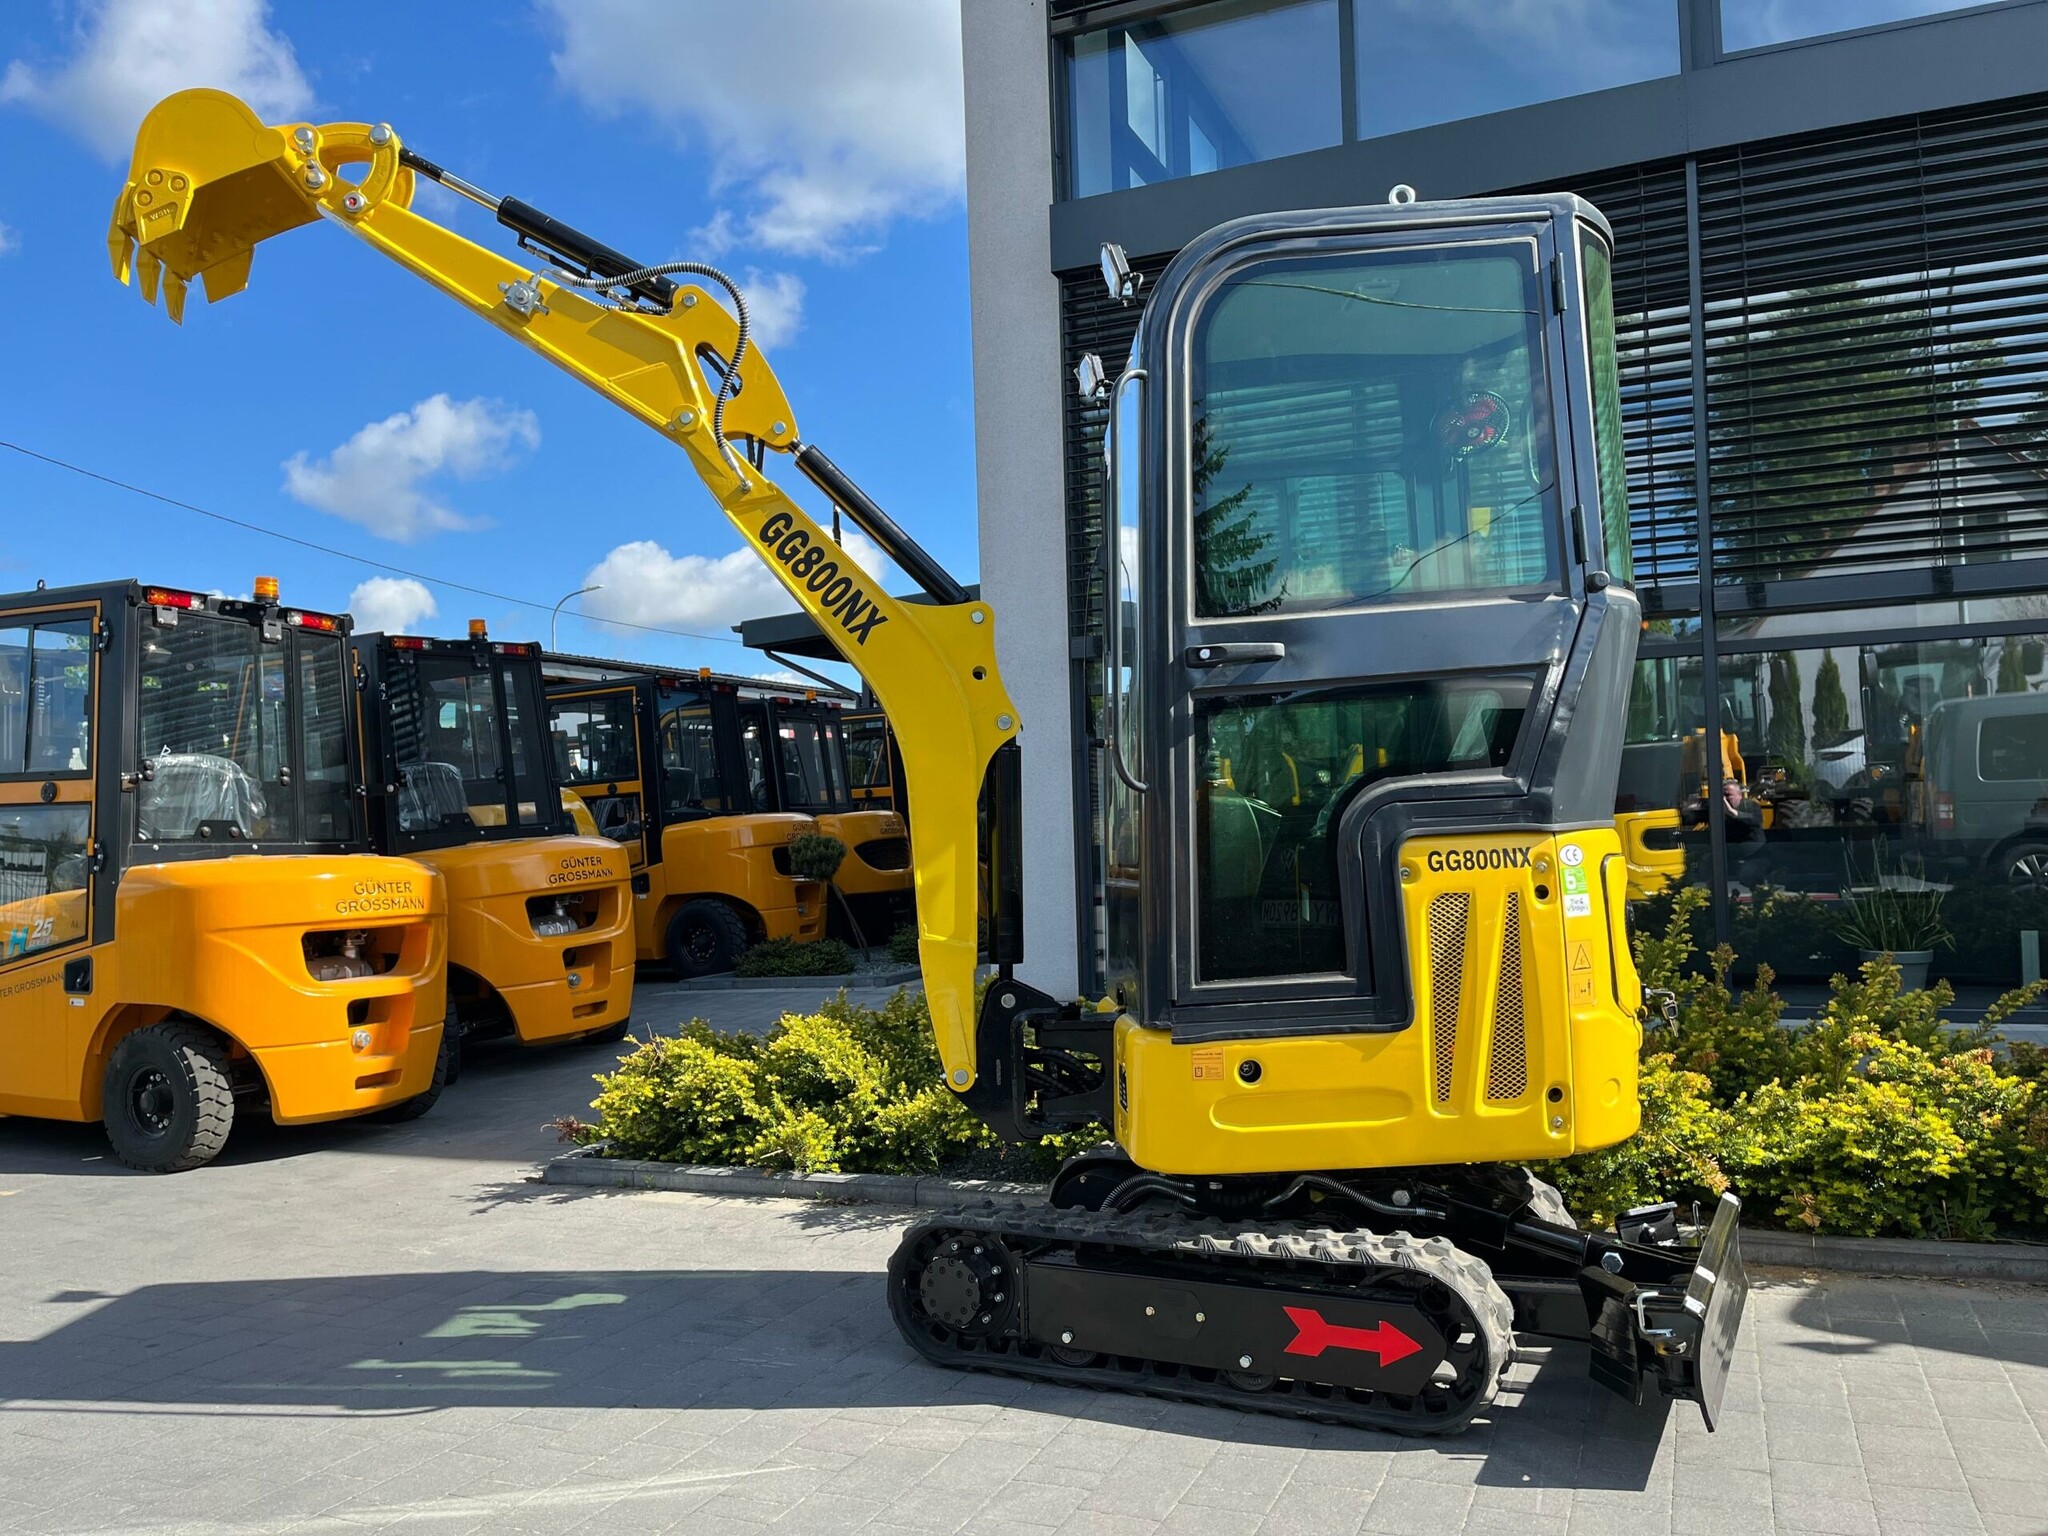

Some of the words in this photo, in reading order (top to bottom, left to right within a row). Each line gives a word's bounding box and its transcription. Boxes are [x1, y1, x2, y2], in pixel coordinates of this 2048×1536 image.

[759, 512, 888, 646] GG800NX
[560, 856, 602, 869] GÜNTER
[1427, 846, 1532, 873] GG800NX
[548, 868, 613, 884] GROSSMANN
[353, 878, 412, 895] GÜNTER
[335, 898, 425, 914] GROSSMANN
[8, 927, 29, 956] H
[32, 917, 54, 939] 25
[14, 971, 64, 994] GROSSMANN
